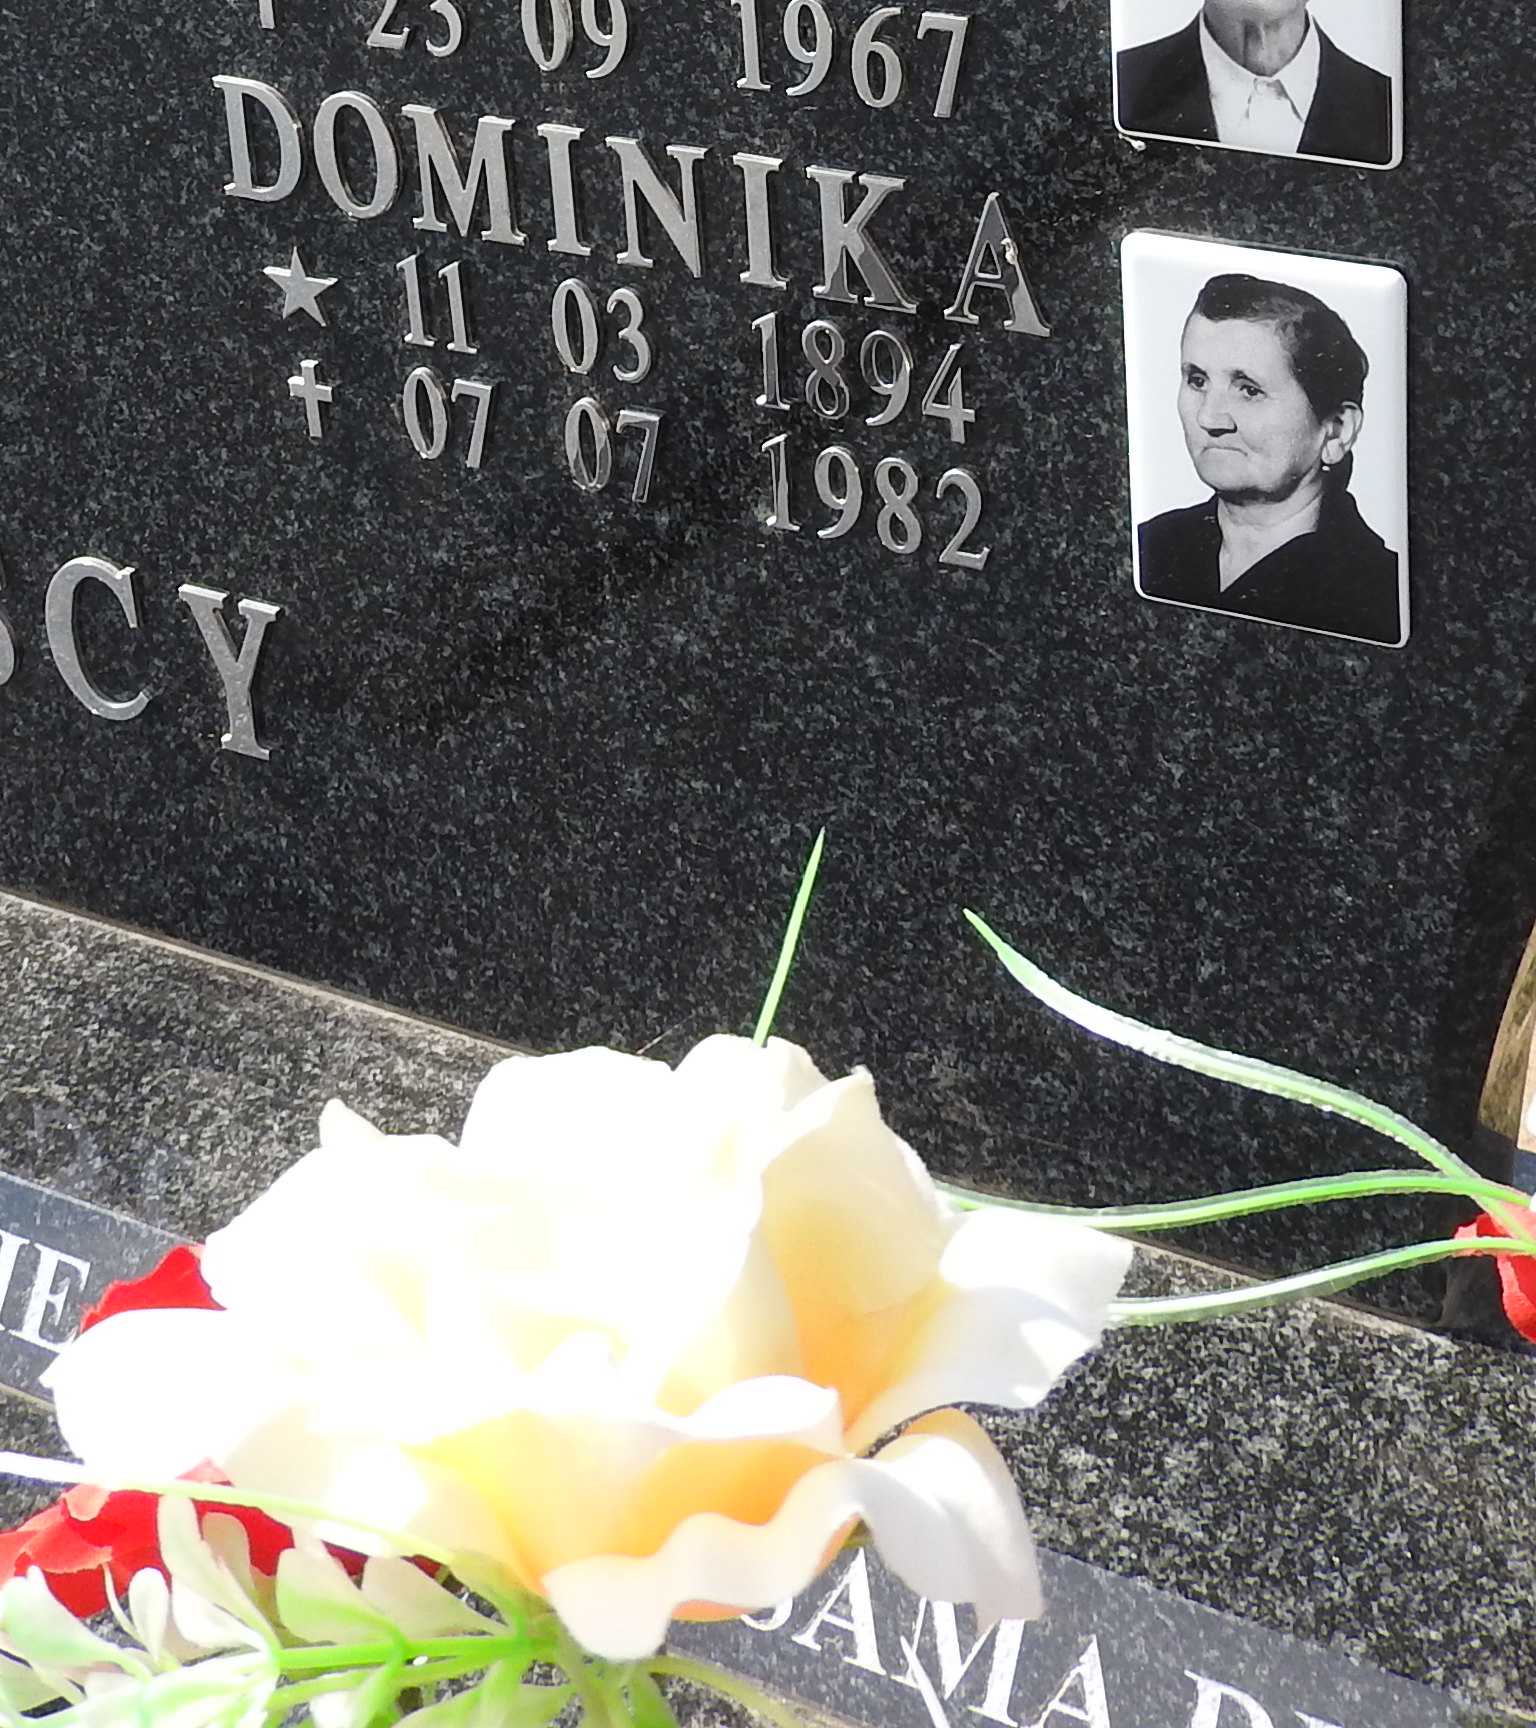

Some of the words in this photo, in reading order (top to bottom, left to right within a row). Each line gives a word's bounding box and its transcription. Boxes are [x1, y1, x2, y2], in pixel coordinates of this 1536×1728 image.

[213, 75, 1051, 337] DOMINIKA
[396, 254, 478, 355] 11
[551, 277, 652, 383] 03
[752, 313, 976, 443] 1894
[401, 366, 495, 469] 07
[564, 396, 662, 503] 07
[760, 434, 992, 569] 1982
[741, 1547, 1112, 1728] AMA
